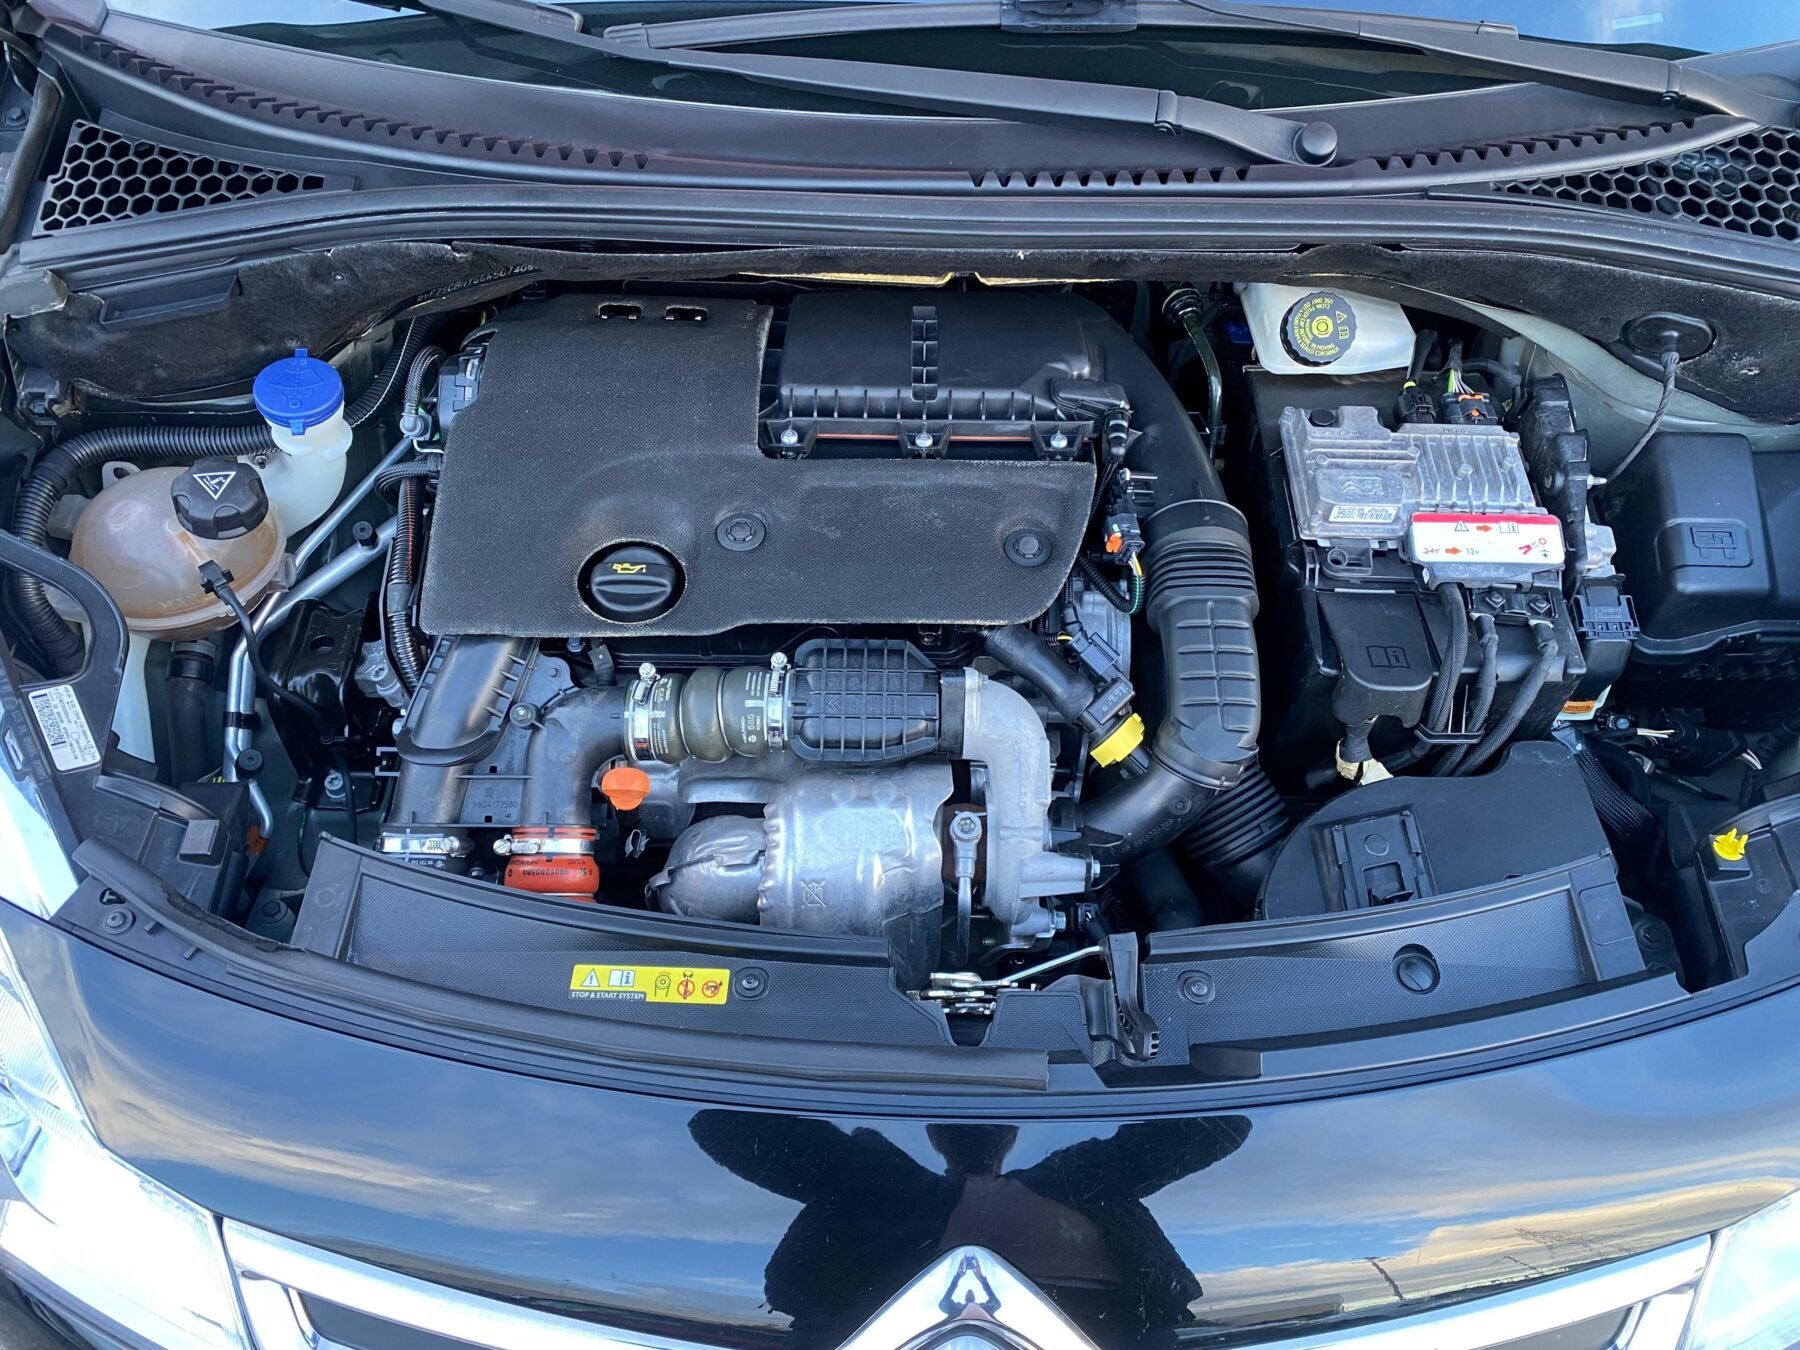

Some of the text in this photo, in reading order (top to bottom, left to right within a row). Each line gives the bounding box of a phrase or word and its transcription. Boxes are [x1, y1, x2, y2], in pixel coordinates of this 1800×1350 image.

[571, 991, 589, 999] STOP
[596, 991, 617, 999] START
[618, 992, 645, 1000] SYSTEM
